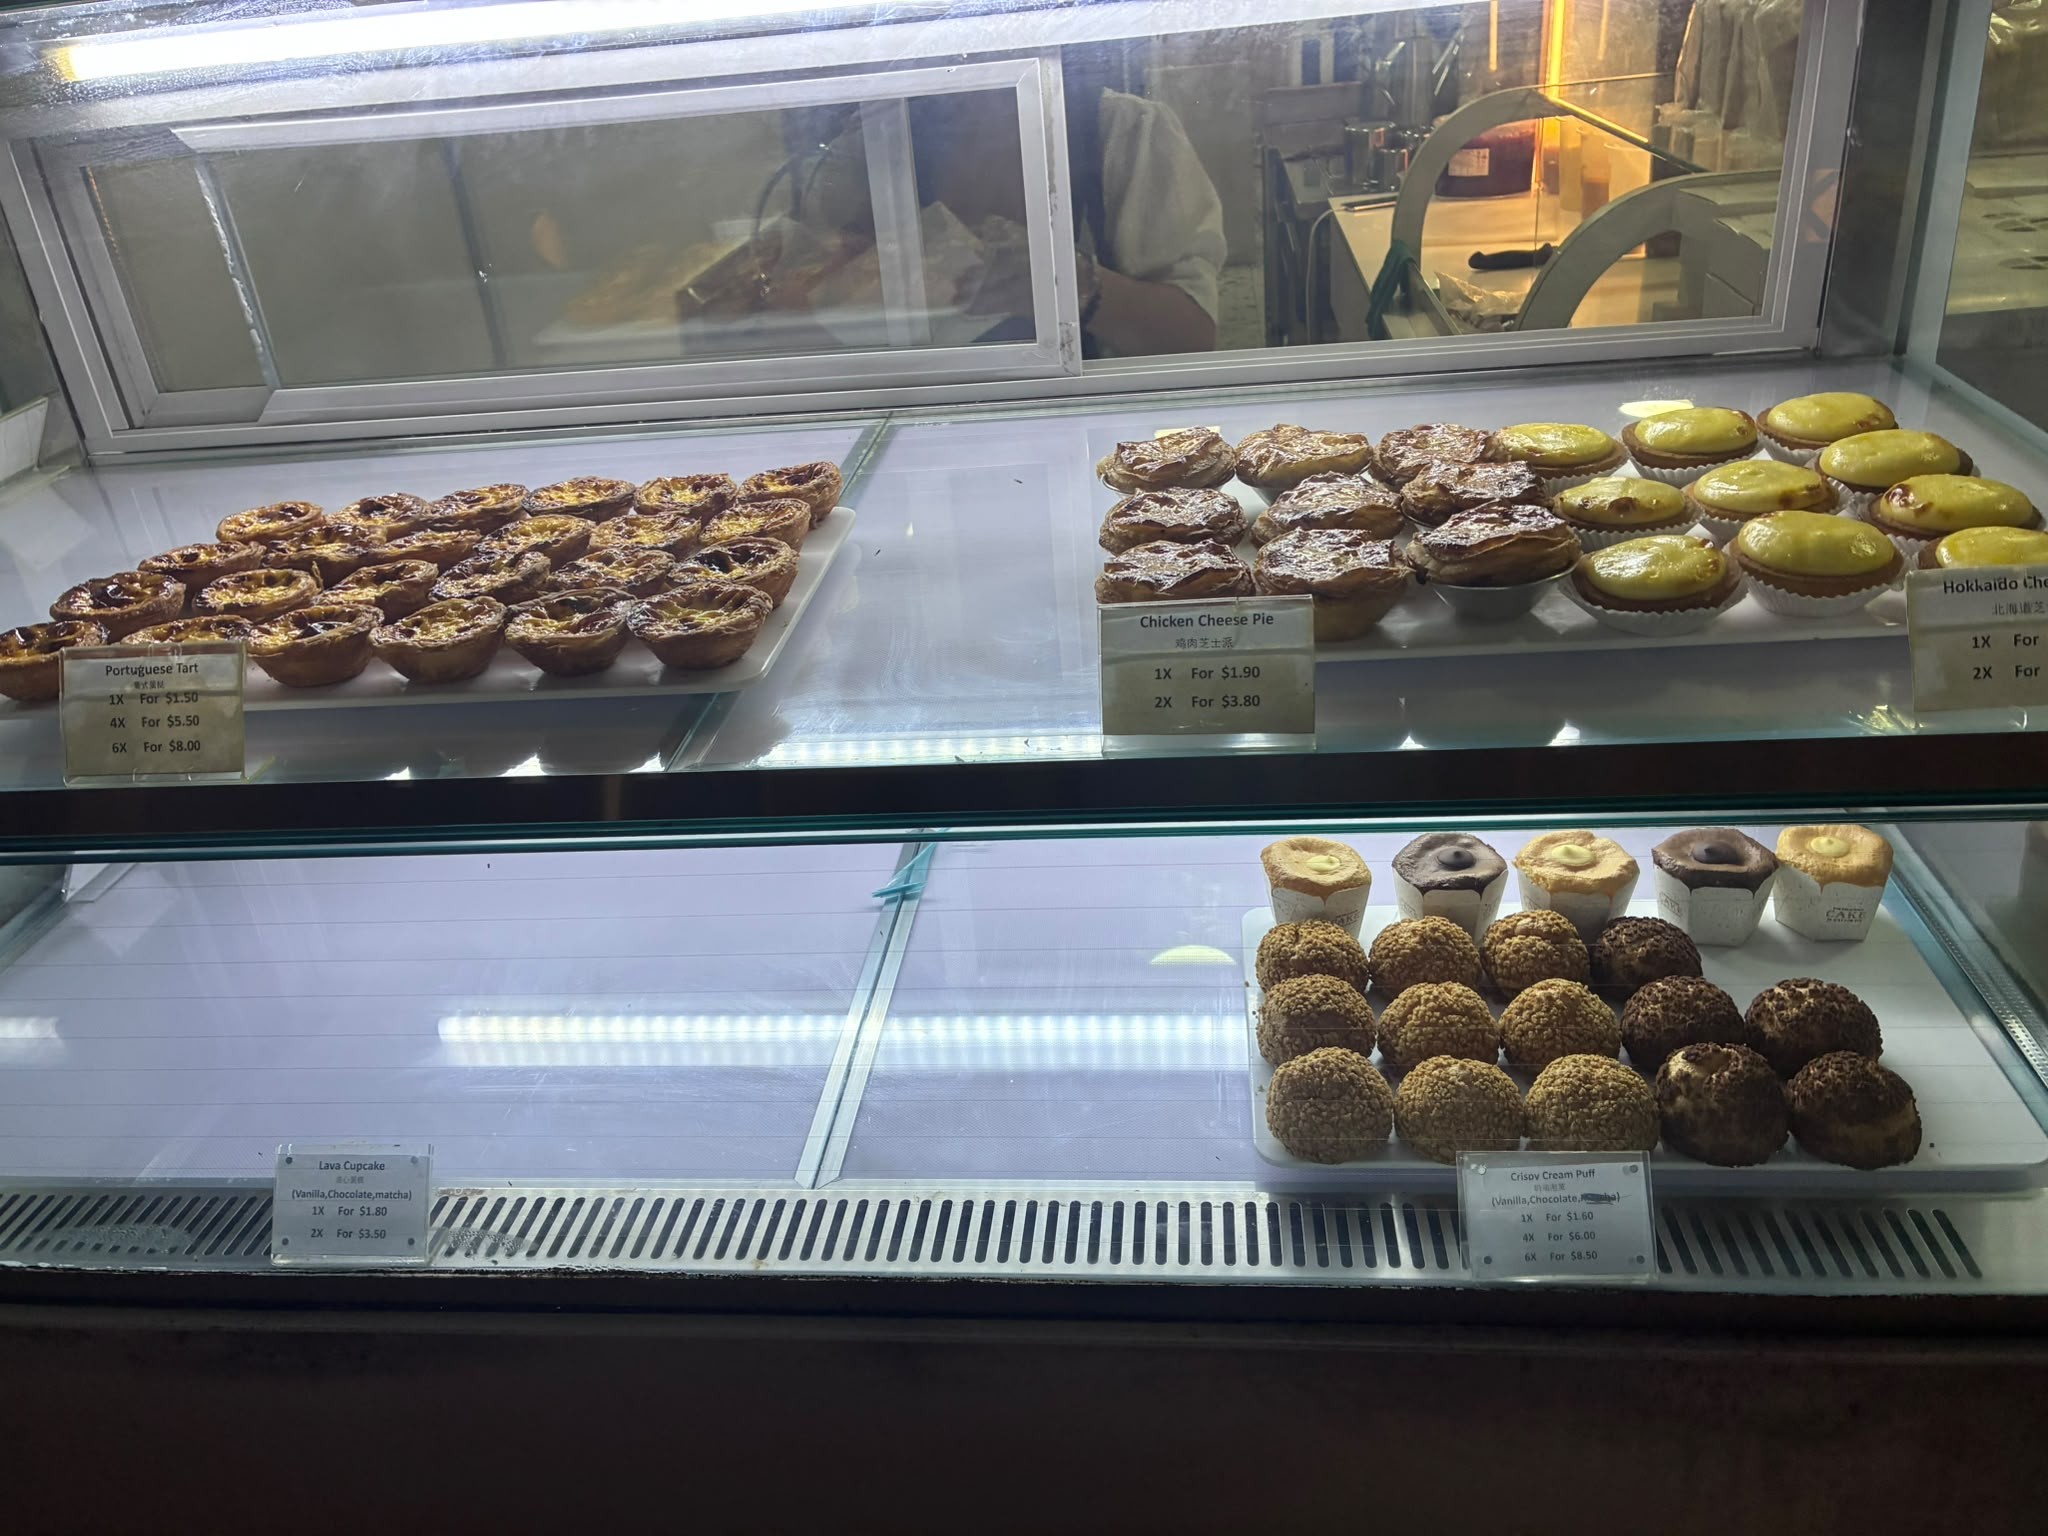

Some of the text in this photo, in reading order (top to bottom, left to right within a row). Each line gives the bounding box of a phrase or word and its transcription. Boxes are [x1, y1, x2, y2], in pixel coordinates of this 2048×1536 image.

[1943, 577, 2018, 594] Hokkaido
[1140, 613, 1274, 628] Chicken Cheese Pie
[1972, 633, 2039, 648] 1X For
[105, 663, 199, 676] Portuguese Tart
[1155, 665, 1261, 680] 1X For $1.90
[1973, 665, 2040, 680] 2X For
[109, 691, 199, 705] 1X For $1.50
[1155, 694, 1261, 708] 2X For $3.80
[110, 714, 200, 728] 4X For $5.50
[112, 740, 201, 753] 6X For $8.00
[319, 1161, 386, 1171] Lava Cupcake
[1542, 1171, 1574, 1180] Cream
[1576, 1168, 1596, 1178] Puff
[292, 1189, 412, 1201] (Vanilla,Chocolate,matcha)
[311, 1206, 388, 1217] 1X For $1.80
[1521, 1211, 1594, 1223] 1X For $1.60
[310, 1228, 386, 1240] 2X For $3.50
[1522, 1230, 1596, 1242] 4X For $6.00
[1524, 1250, 1598, 1262] 6X For $8.50
